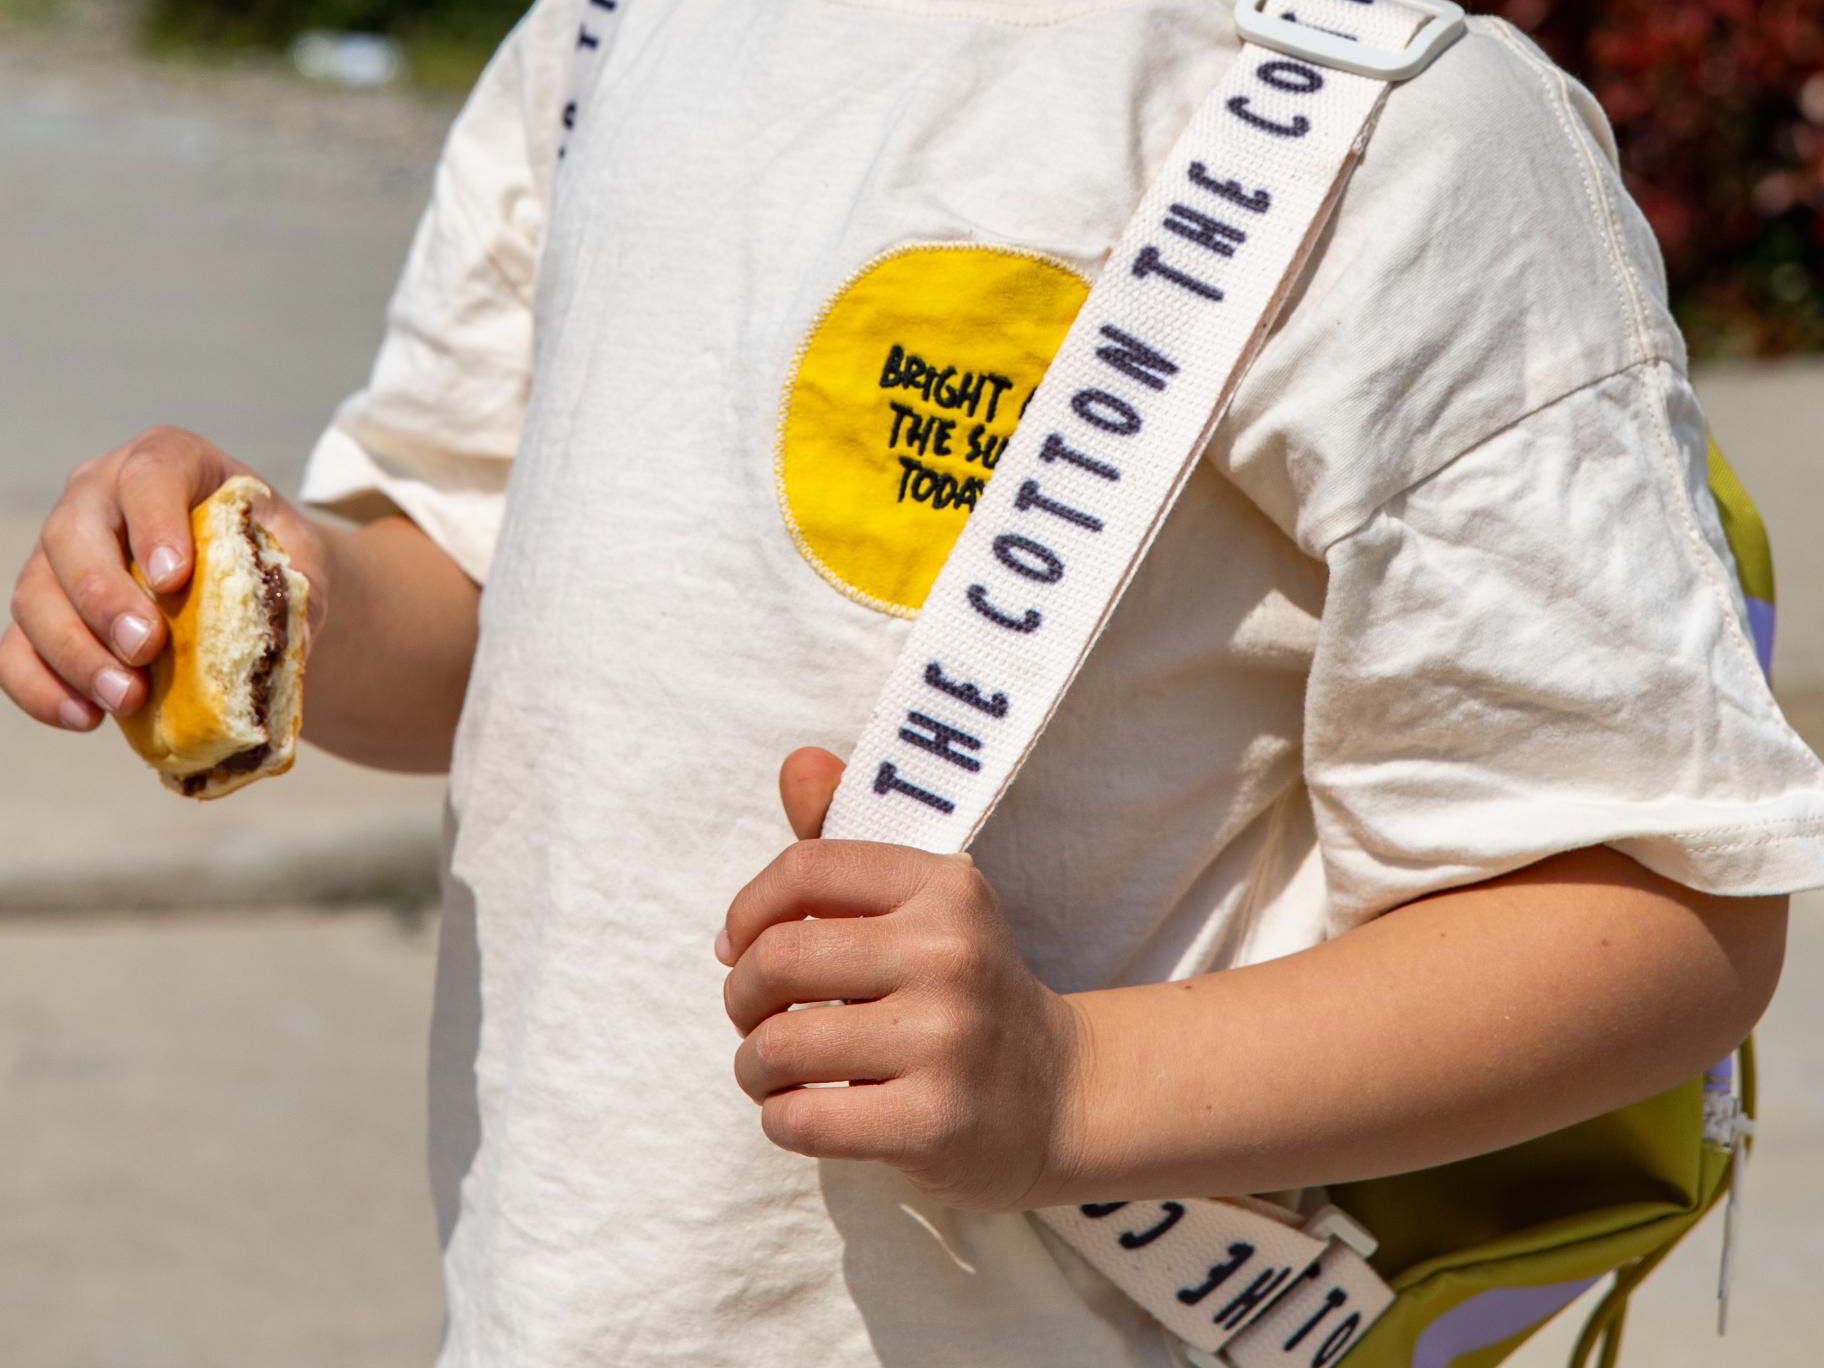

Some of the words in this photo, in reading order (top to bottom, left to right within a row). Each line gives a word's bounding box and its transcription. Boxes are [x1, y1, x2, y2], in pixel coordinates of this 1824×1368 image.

[879, 344, 1014, 423] BRIGHT
[889, 400, 957, 457] THE
[872, 662, 1009, 815] THE
[966, 323, 1180, 635] COTTON
[1131, 161, 1272, 303] THE
